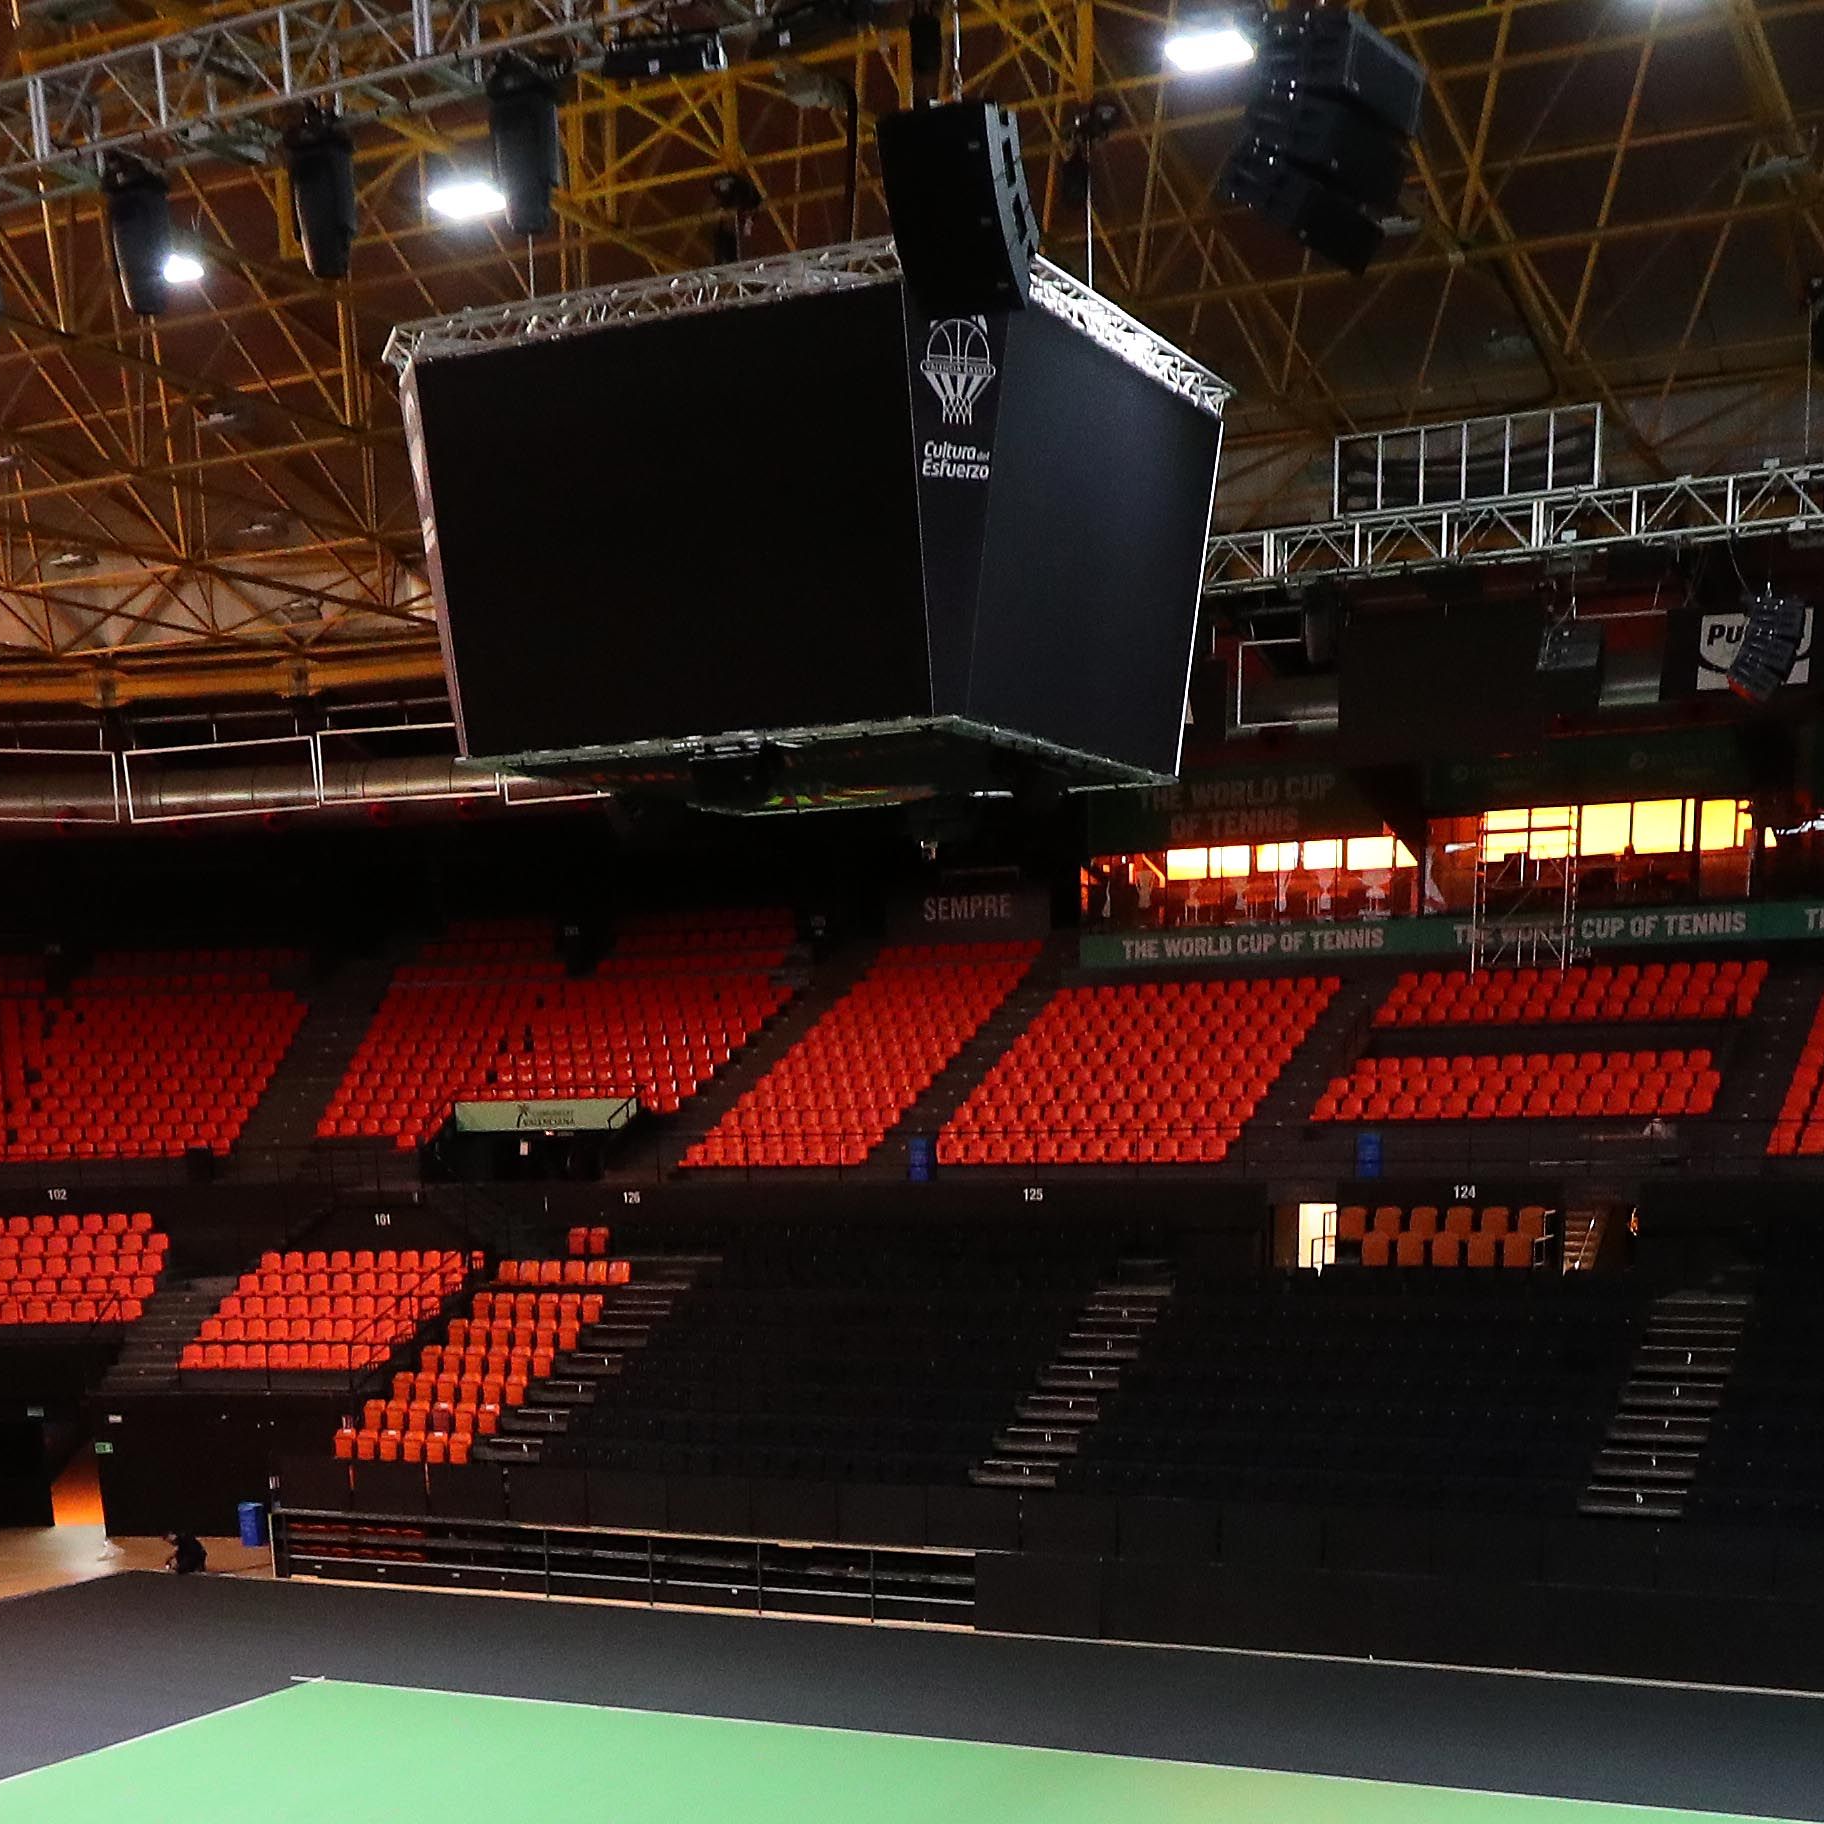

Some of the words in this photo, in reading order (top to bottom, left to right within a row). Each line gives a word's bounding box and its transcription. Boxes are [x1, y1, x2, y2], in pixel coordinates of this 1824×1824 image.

[924, 440, 976, 461] Cultura
[922, 458, 990, 480] Esfuerzo
[1139, 784, 1183, 811] THE
[1191, 776, 1279, 809] WORLD
[1285, 773, 1336, 802] CUP
[1169, 812, 1201, 838] OF
[1209, 807, 1299, 837] TENNIS
[923, 894, 1012, 922] SEMPRE
[1581, 915, 1623, 940] CUP
[1628, 914, 1658, 938] OF
[1664, 910, 1747, 936] TENNIS
[1122, 938, 1160, 961] THE
[1163, 935, 1230, 958] WORLD
[1236, 933, 1275, 955] CUP
[1279, 931, 1306, 953] OF
[1311, 926, 1385, 952] TENNIS
[48, 1188, 68, 1201] 102
[1023, 1187, 1043, 1202] 125
[1453, 1184, 1476, 1199] 124
[374, 1212, 392, 1227] 101
